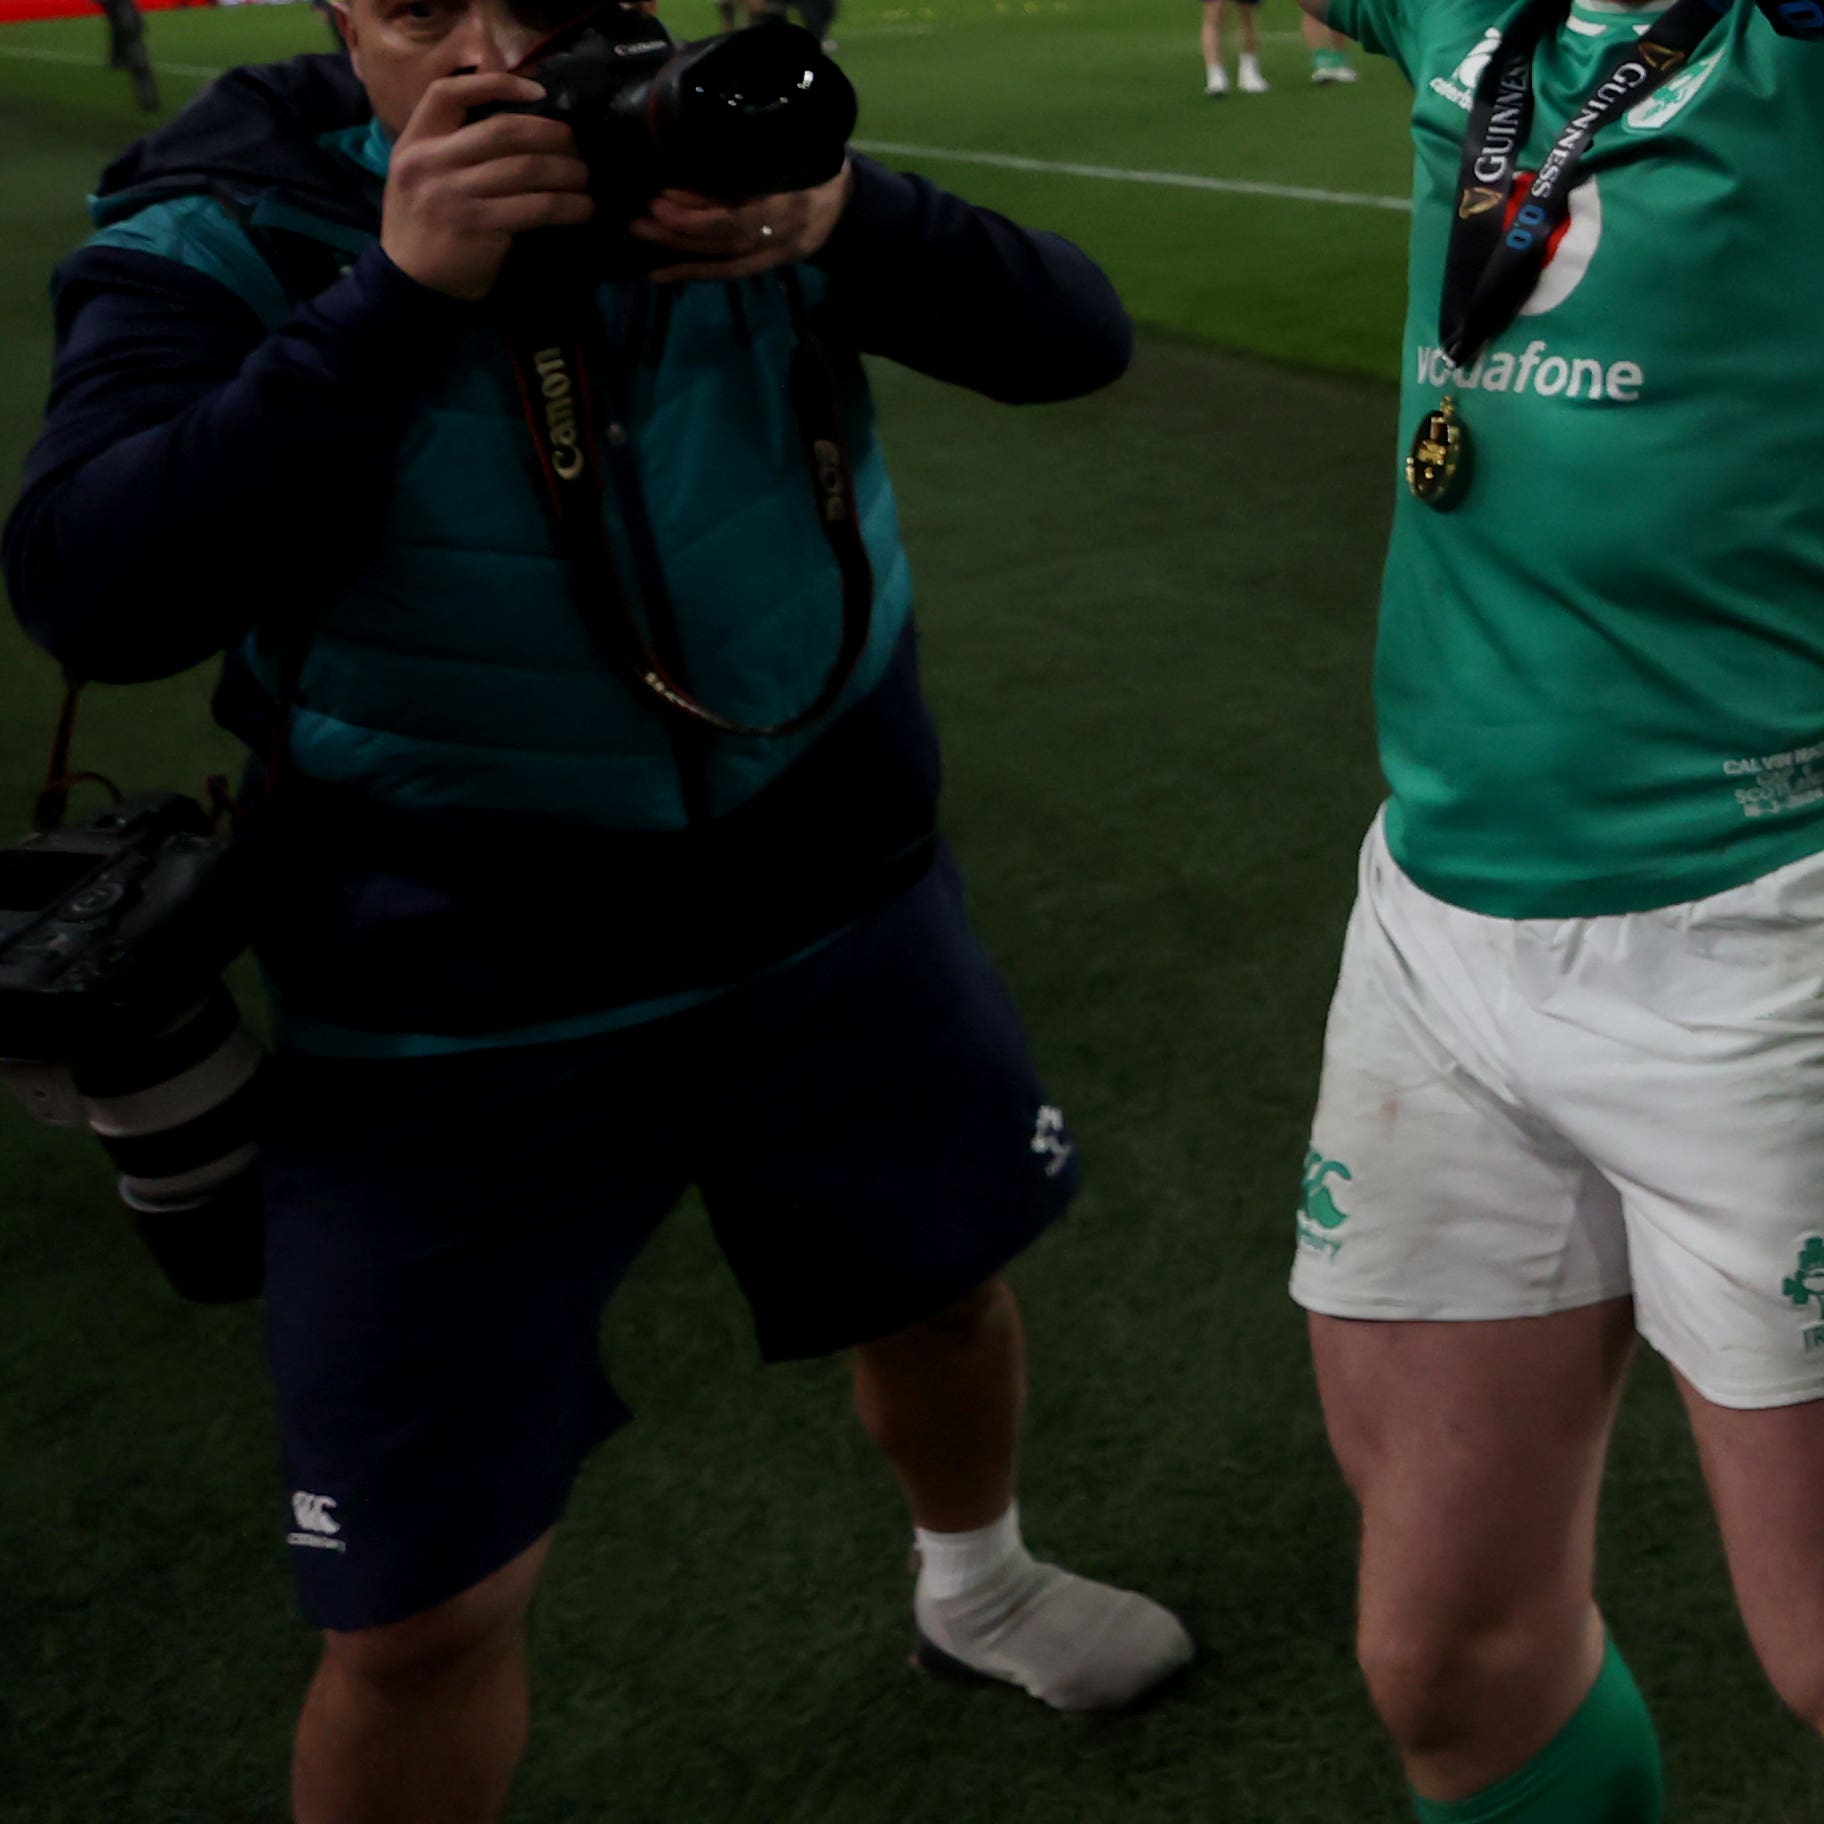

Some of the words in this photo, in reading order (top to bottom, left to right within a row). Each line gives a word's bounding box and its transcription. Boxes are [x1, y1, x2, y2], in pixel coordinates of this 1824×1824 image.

[1531, 63, 1646, 198] GUINNESS
[1506, 204, 1545, 250] 0.0
[1416, 340, 1643, 401] vodafone
[532, 346, 584, 481] Canon
[1723, 753, 1793, 775] CALVIN
